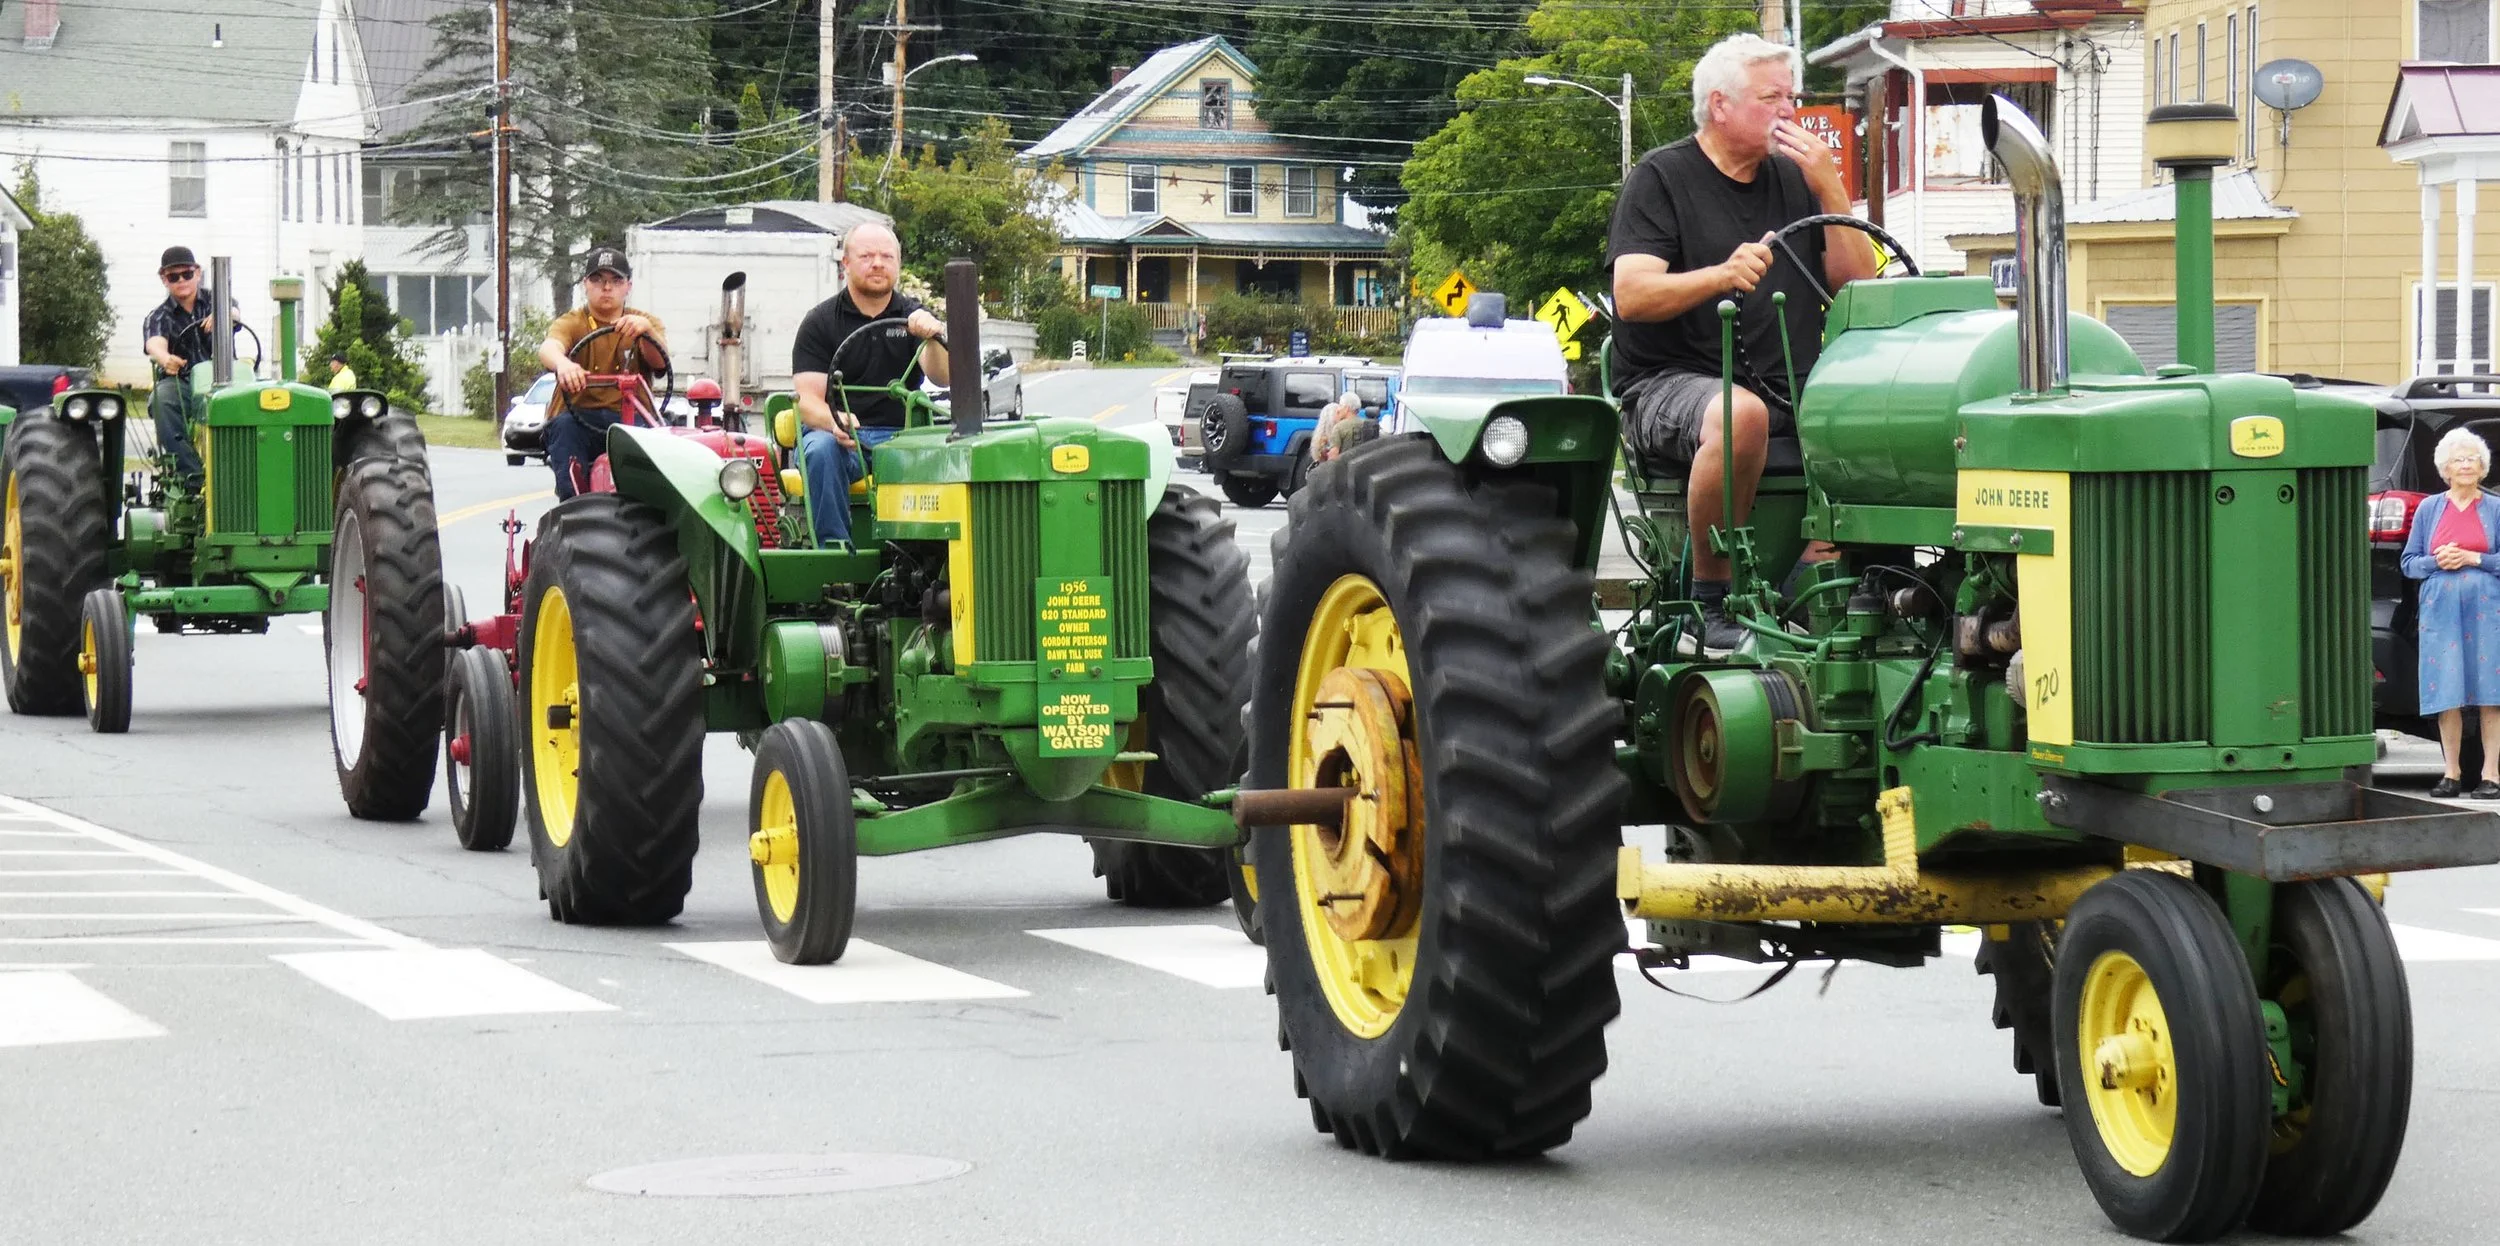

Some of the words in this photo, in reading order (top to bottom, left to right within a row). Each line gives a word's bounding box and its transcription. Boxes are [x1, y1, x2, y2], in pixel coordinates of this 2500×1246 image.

[1800, 116, 1833, 130] W.E.
[920, 495, 940, 512] DEERE
[1975, 487, 2003, 506] JOHN
[2009, 489, 2049, 509] DEERE
[1060, 580, 1087, 595] 1956
[1047, 596, 1070, 607] JOHN
[1072, 595, 1101, 606] DEERE
[1041, 609, 1059, 620] 620
[1062, 608, 1107, 620] STANDARD
[1059, 622, 1090, 633] OWNER
[1042, 636, 1071, 647] GORDON
[1072, 635, 1107, 646] PETERSON
[1047, 650, 1067, 660] DAWN
[1069, 649, 1082, 659] TILL
[1084, 648, 1102, 659] DUSK
[1065, 662, 1085, 673] FARM
[2035, 668, 2059, 710] 720
[1060, 694, 1091, 705] NOW
[1042, 704, 1110, 716] OPERATED
[1067, 714, 1085, 725] BY
[1042, 723, 1111, 738] WATSON
[1051, 735, 1104, 750] GATES
